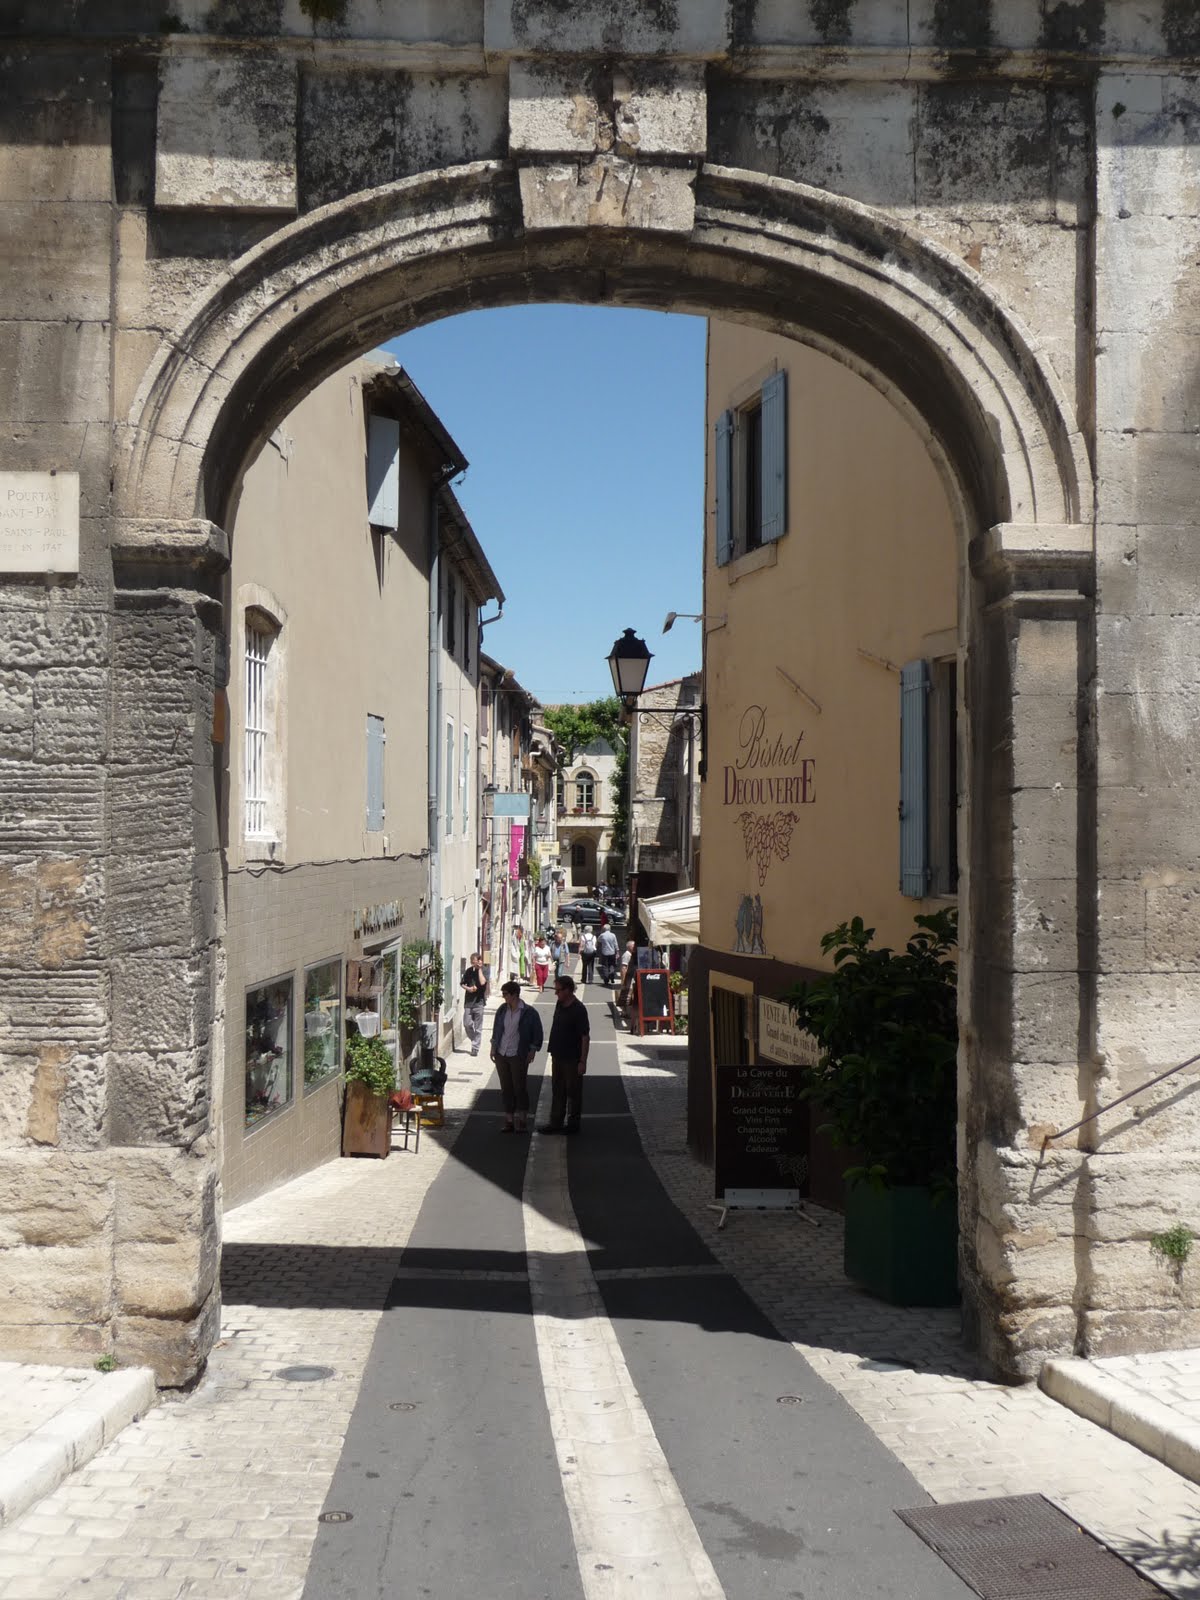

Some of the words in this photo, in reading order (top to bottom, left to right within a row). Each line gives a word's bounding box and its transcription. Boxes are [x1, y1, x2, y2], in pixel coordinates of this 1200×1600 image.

[736, 705, 804, 769] Bistrot
[723, 759, 816, 805] DECOUVERTE
[737, 1069, 748, 1078] La
[750, 1069, 774, 1078] Cave
[775, 1068, 788, 1078] du
[732, 1106, 757, 1115] Grand
[758, 1106, 781, 1115] Choix
[783, 1105, 793, 1114] de
[745, 1116, 763, 1124] Vins
[737, 1126, 788, 1136] Champagnes
[748, 1135, 777, 1144] Alcools
[745, 1145, 779, 1153] Cadeaux
